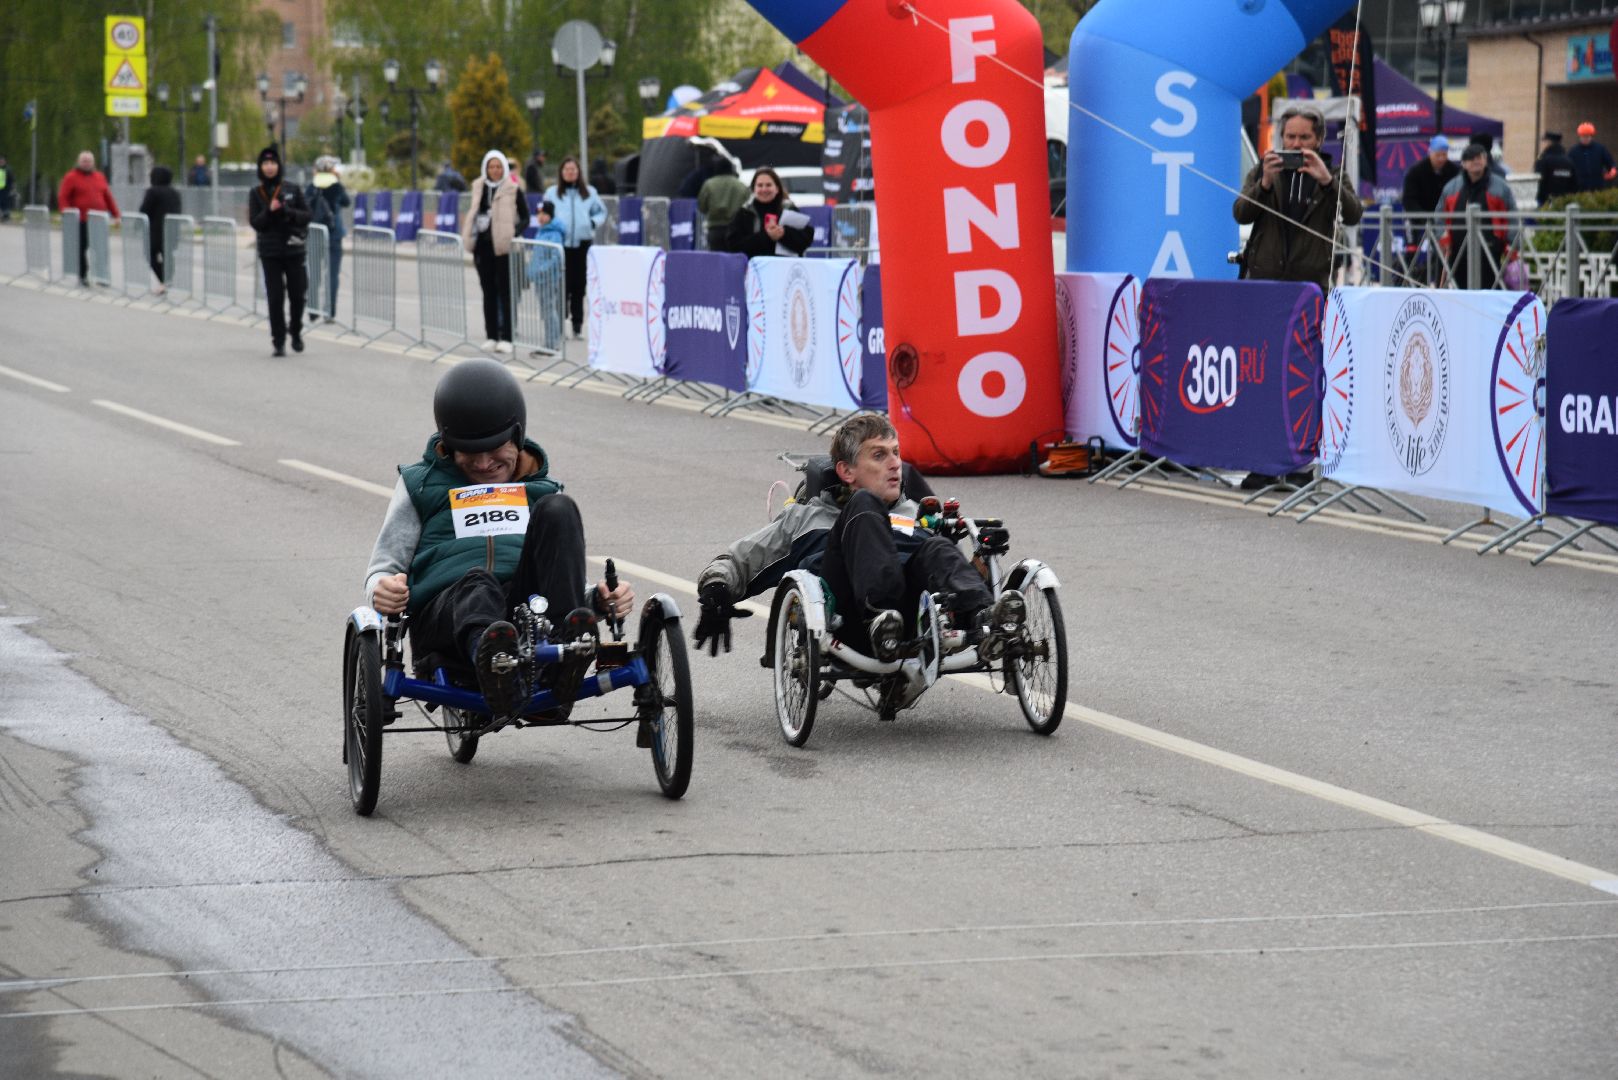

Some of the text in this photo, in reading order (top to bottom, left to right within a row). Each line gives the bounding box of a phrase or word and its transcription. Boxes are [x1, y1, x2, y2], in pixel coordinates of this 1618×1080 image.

[941, 14, 1026, 418] FONDO
[668, 306, 693, 331] GRAN
[693, 305, 723, 333] FONDO
[1560, 393, 1618, 436] GRA
[1406, 433, 1426, 477] life
[464, 510, 520, 527] 2186
